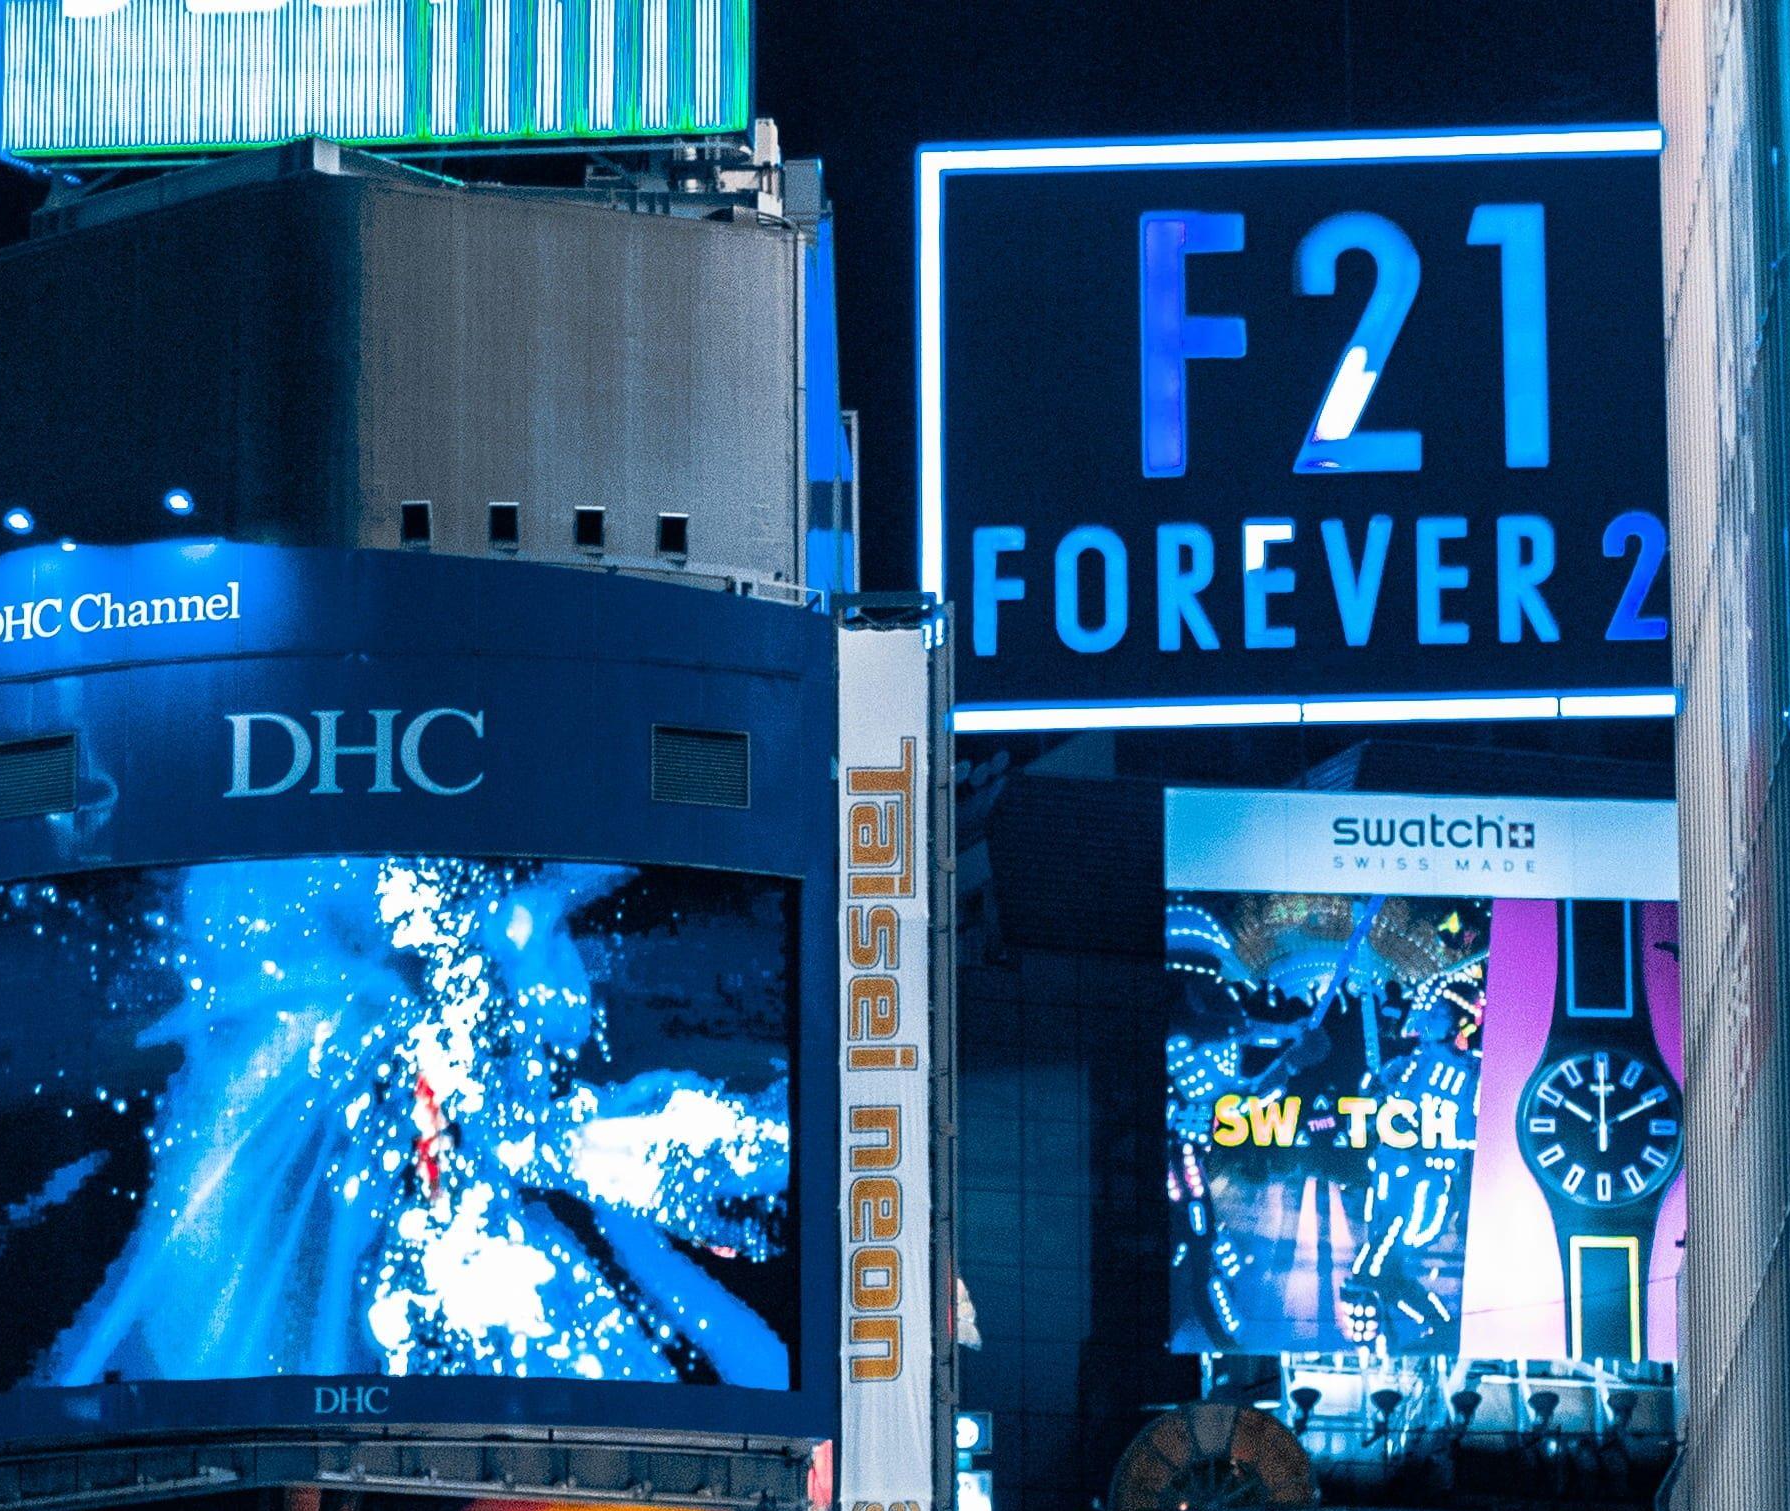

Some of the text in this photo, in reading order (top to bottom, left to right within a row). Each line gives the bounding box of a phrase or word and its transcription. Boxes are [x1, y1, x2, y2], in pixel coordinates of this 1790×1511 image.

[1139, 202, 1550, 476] F21
[69, 582, 241, 637] Channel
[973, 514, 1561, 657] FOREVER
[223, 707, 484, 798] DHC
[1332, 814, 1505, 850] swatch
[1333, 856, 1537, 873] SWISS MADE
[845, 736, 917, 1385] Taisei neon
[315, 1386, 389, 1414] DHC
